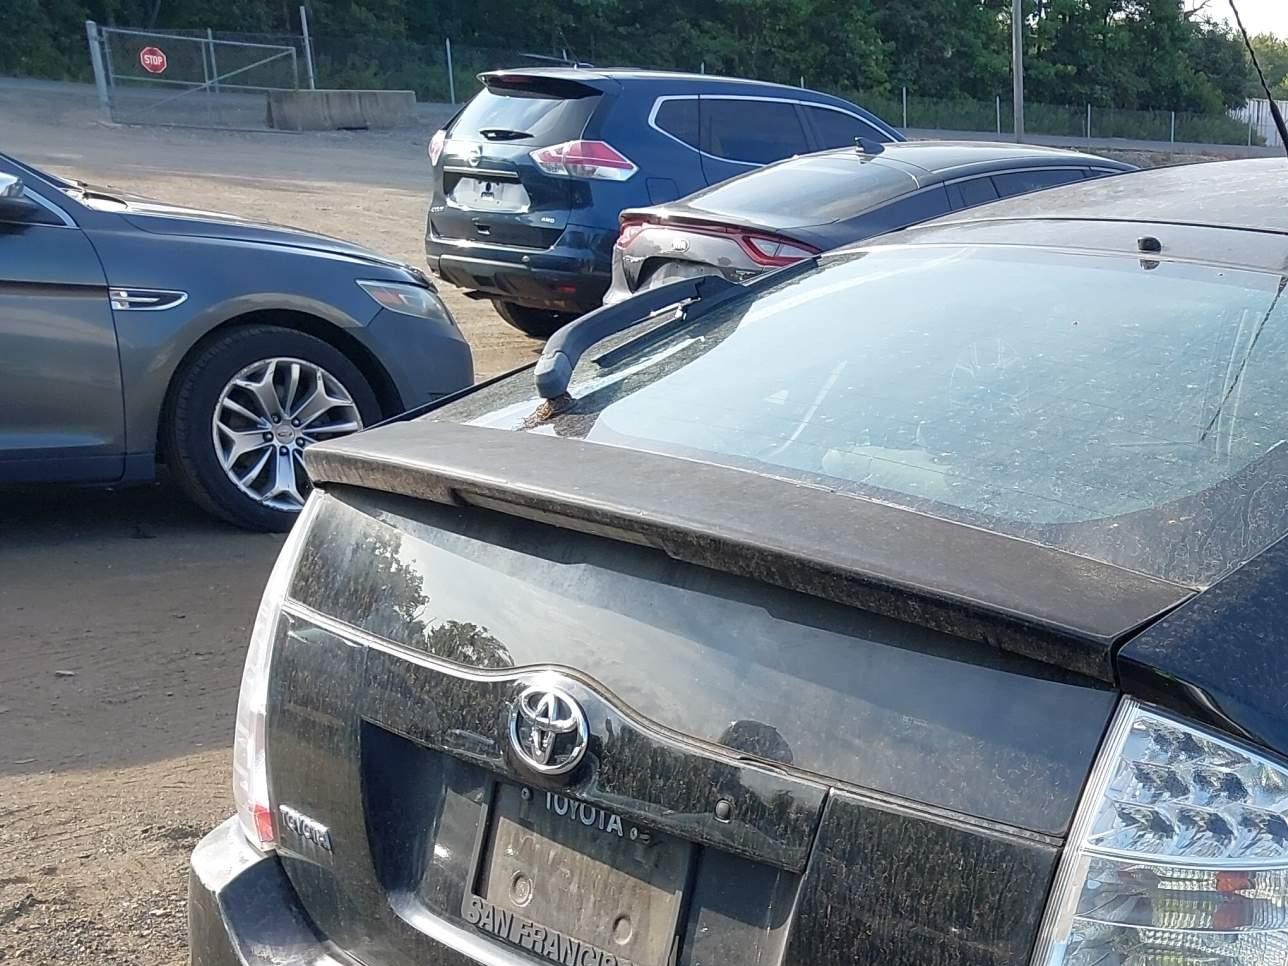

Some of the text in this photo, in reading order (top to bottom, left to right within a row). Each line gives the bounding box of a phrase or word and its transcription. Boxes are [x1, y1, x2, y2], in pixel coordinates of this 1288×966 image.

[144, 55, 163, 65] STOP
[279, 804, 333, 851] TOYOTA
[467, 894, 513, 940] SAN
